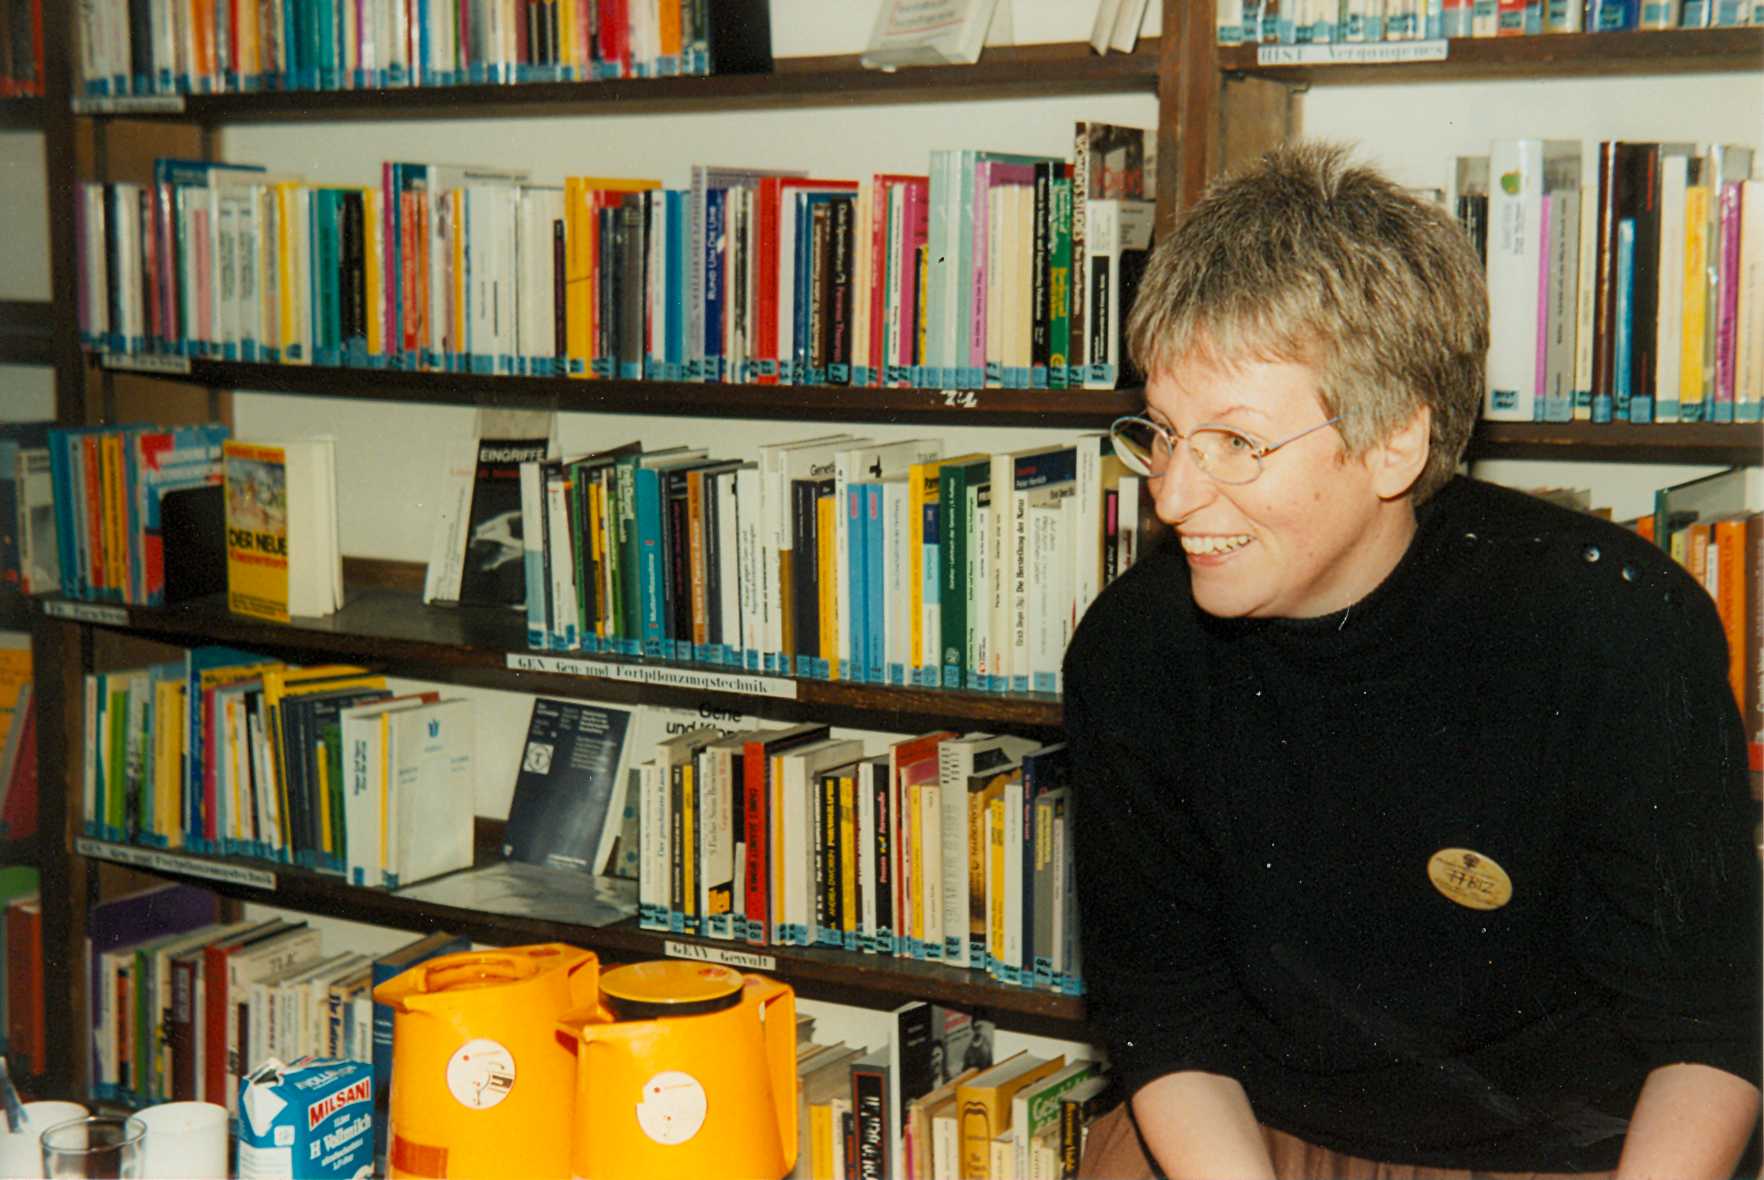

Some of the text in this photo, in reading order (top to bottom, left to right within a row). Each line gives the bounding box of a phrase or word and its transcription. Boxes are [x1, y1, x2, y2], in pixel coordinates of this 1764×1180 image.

[1073, 195, 1086, 241] STUDIES
[479, 447, 546, 463] EINGRIFFE
[1015, 498, 1025, 520] Natur
[228, 527, 288, 556] DER NEUE
[1015, 521, 1025, 534] der
[1014, 536, 1025, 579] Herstellung
[1015, 580, 1025, 593] Die
[518, 658, 546, 670] GEN
[616, 664, 769, 694] Fortpflanzungstechnik
[673, 943, 768, 967] GEW Gewalt
[309, 1078, 371, 1129] MILSANI
[310, 1139, 322, 1160] H
[322, 1112, 372, 1152] Vollmilch
